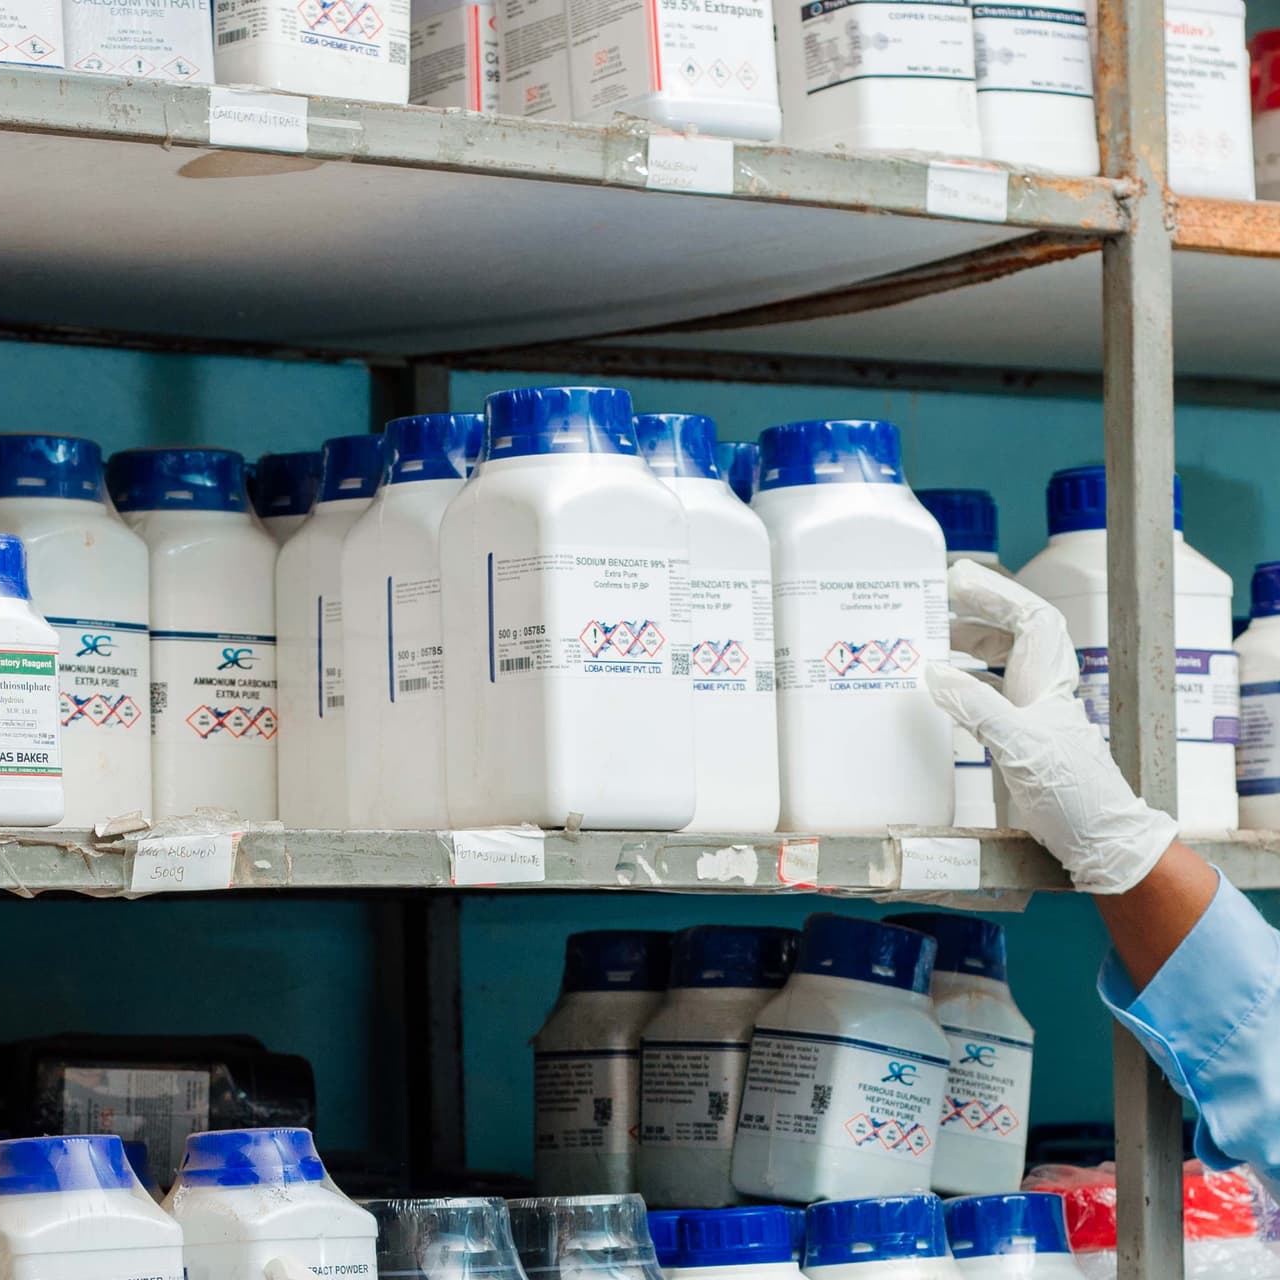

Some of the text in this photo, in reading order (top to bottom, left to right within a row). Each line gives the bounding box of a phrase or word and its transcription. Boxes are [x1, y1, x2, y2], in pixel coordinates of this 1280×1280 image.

[704, 2, 764, 19] Extrapure
[576, 557, 607, 567] SODIUM
[608, 558, 648, 569] BENZOATE
[21, 657, 53, 671] Reagent
[584, 664, 604, 674] LOBA
[605, 664, 632, 674] CHEMIE
[1, 681, 52, 694] thiosulphate
[15, 752, 49, 764] BAKER
